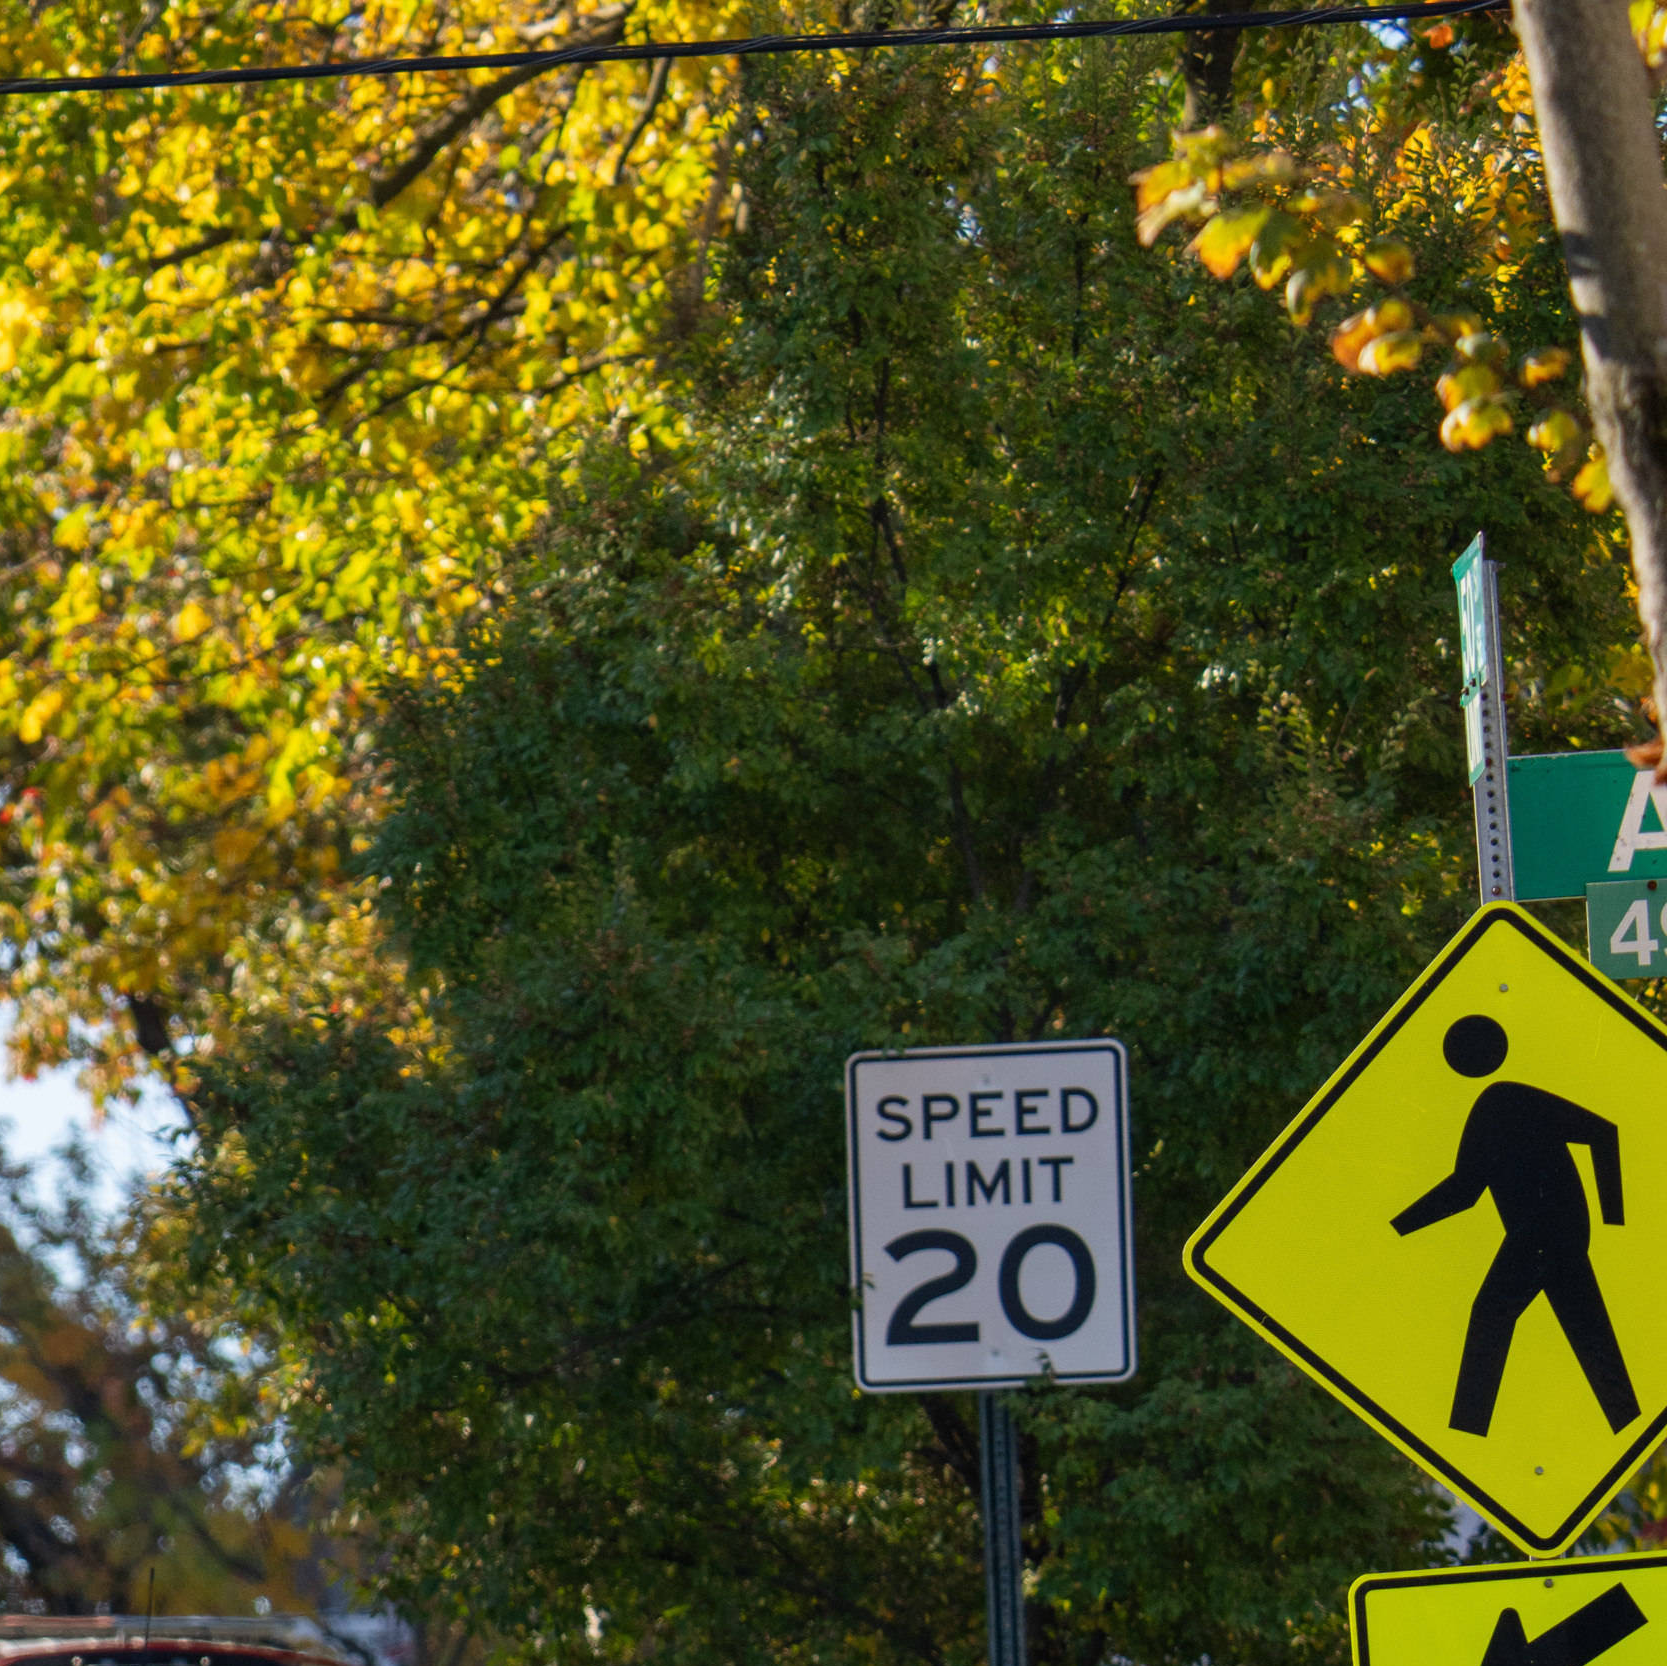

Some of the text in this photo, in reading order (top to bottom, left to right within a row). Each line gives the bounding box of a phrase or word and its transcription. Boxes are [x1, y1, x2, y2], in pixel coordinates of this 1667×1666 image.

[875, 1087, 1099, 1143] SPEED
[901, 1158, 1074, 1210] LIMIT
[883, 1223, 1097, 1347] 20
